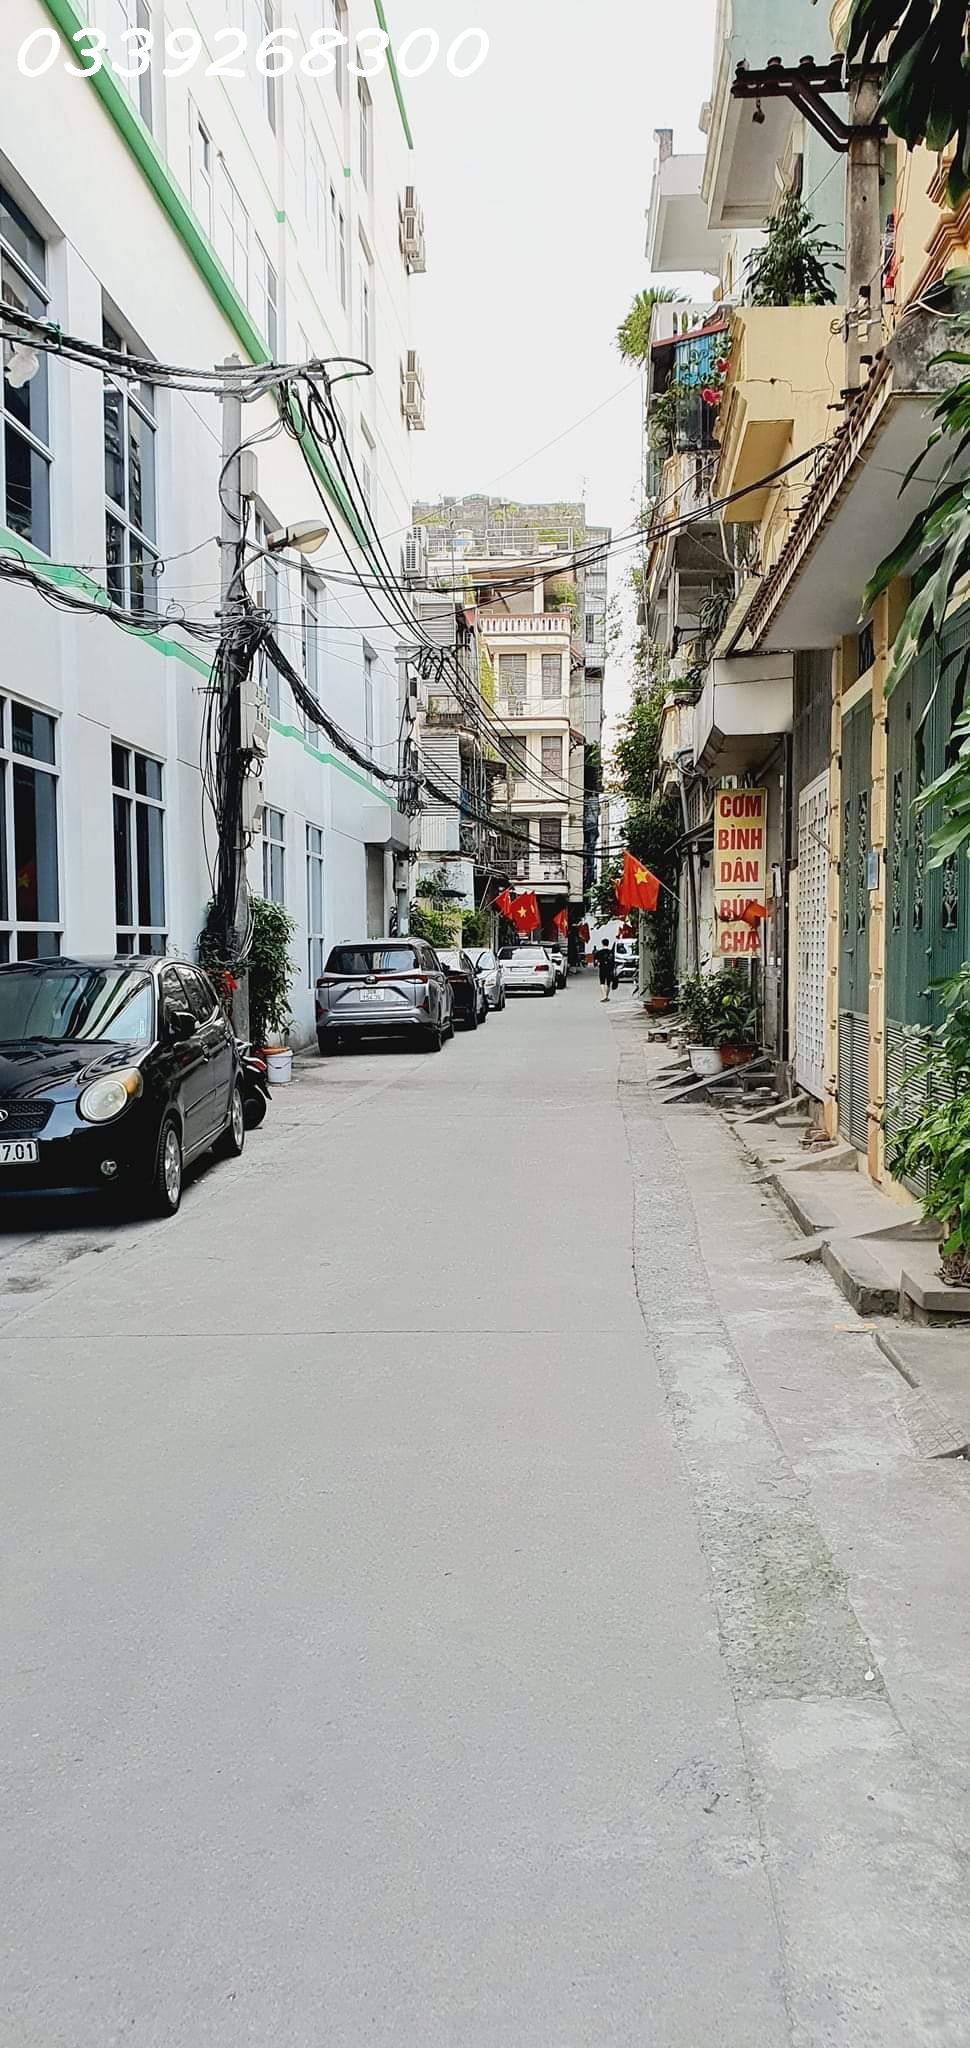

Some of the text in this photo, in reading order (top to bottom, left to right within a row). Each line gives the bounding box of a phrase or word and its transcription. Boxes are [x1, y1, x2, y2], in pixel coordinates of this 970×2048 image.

[720, 793, 762, 818] CƠM
[718, 824, 763, 850] BÌNH
[720, 857, 759, 883] DÂN
[720, 894, 758, 921] BÚ
